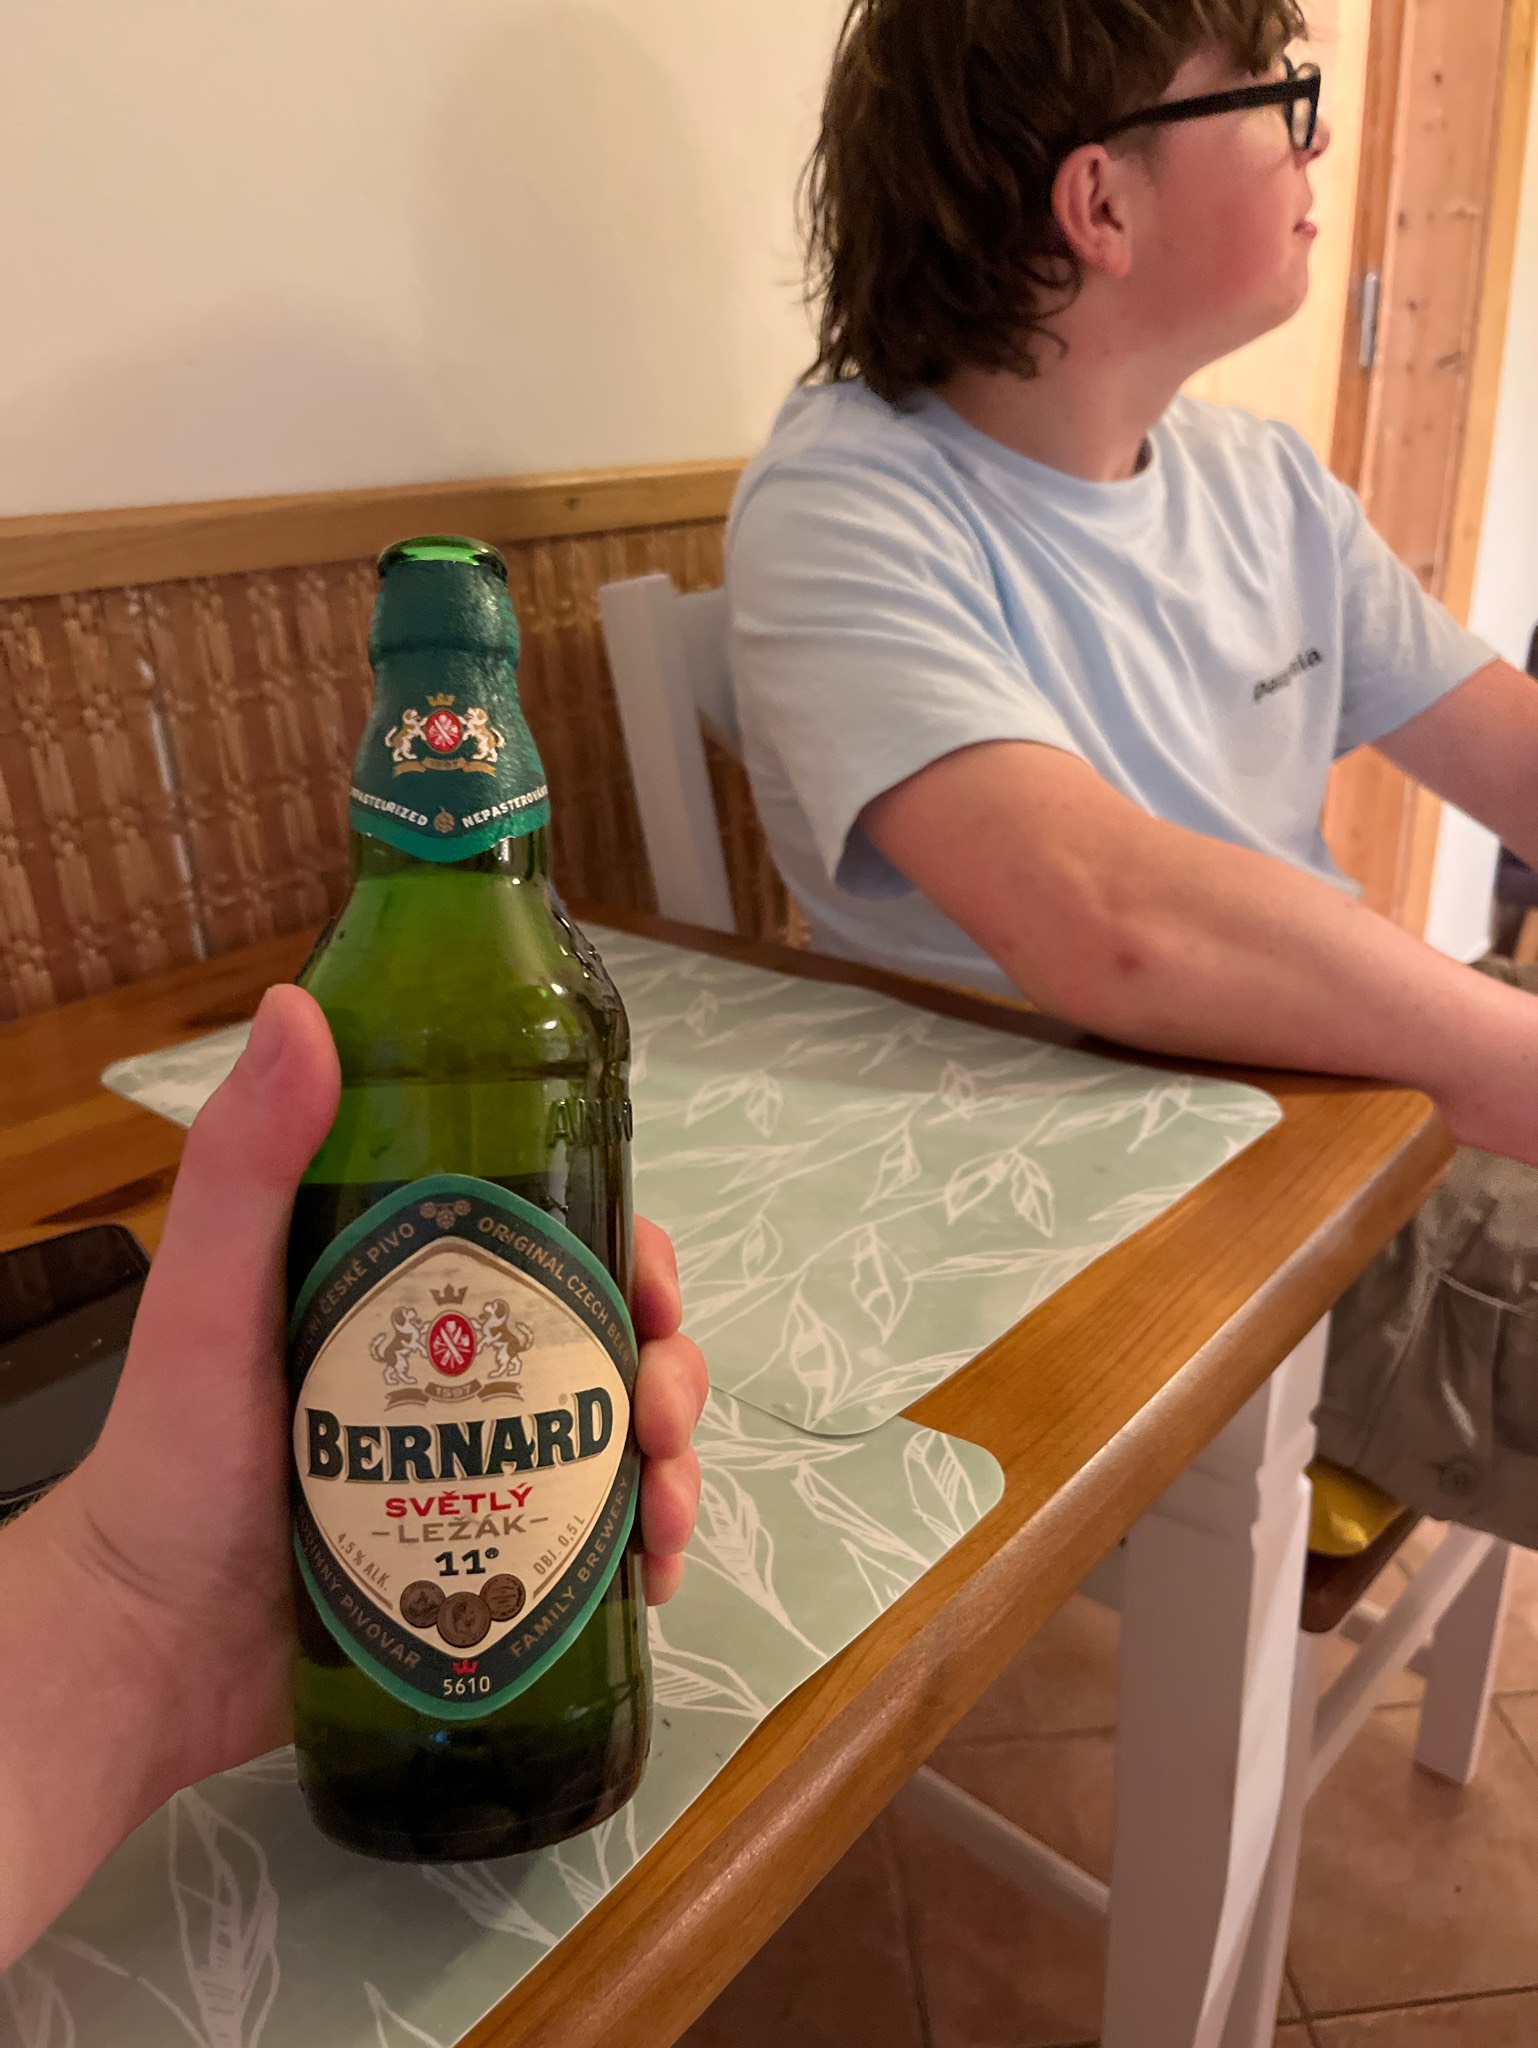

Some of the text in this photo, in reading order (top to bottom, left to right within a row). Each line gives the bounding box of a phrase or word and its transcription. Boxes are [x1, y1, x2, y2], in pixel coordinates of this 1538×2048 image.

[366, 1223, 415, 1263] PIVO
[478, 1216, 563, 1281] ORIGINAL
[566, 1275, 609, 1325] CZECH
[304, 1386, 613, 1482] BERNARD
[385, 1481, 534, 1519] SVĚTLÝ
[337, 1532, 356, 1555] 4,5
[362, 1562, 390, 1591] ALK.
[510, 1476, 629, 1658] FAMILY BREWERY
[532, 1549, 562, 1575] OBJ.
[557, 1522, 578, 1547] 0,5
[341, 1594, 421, 1669] PIVOVAR
[442, 1675, 491, 1696] 5610
